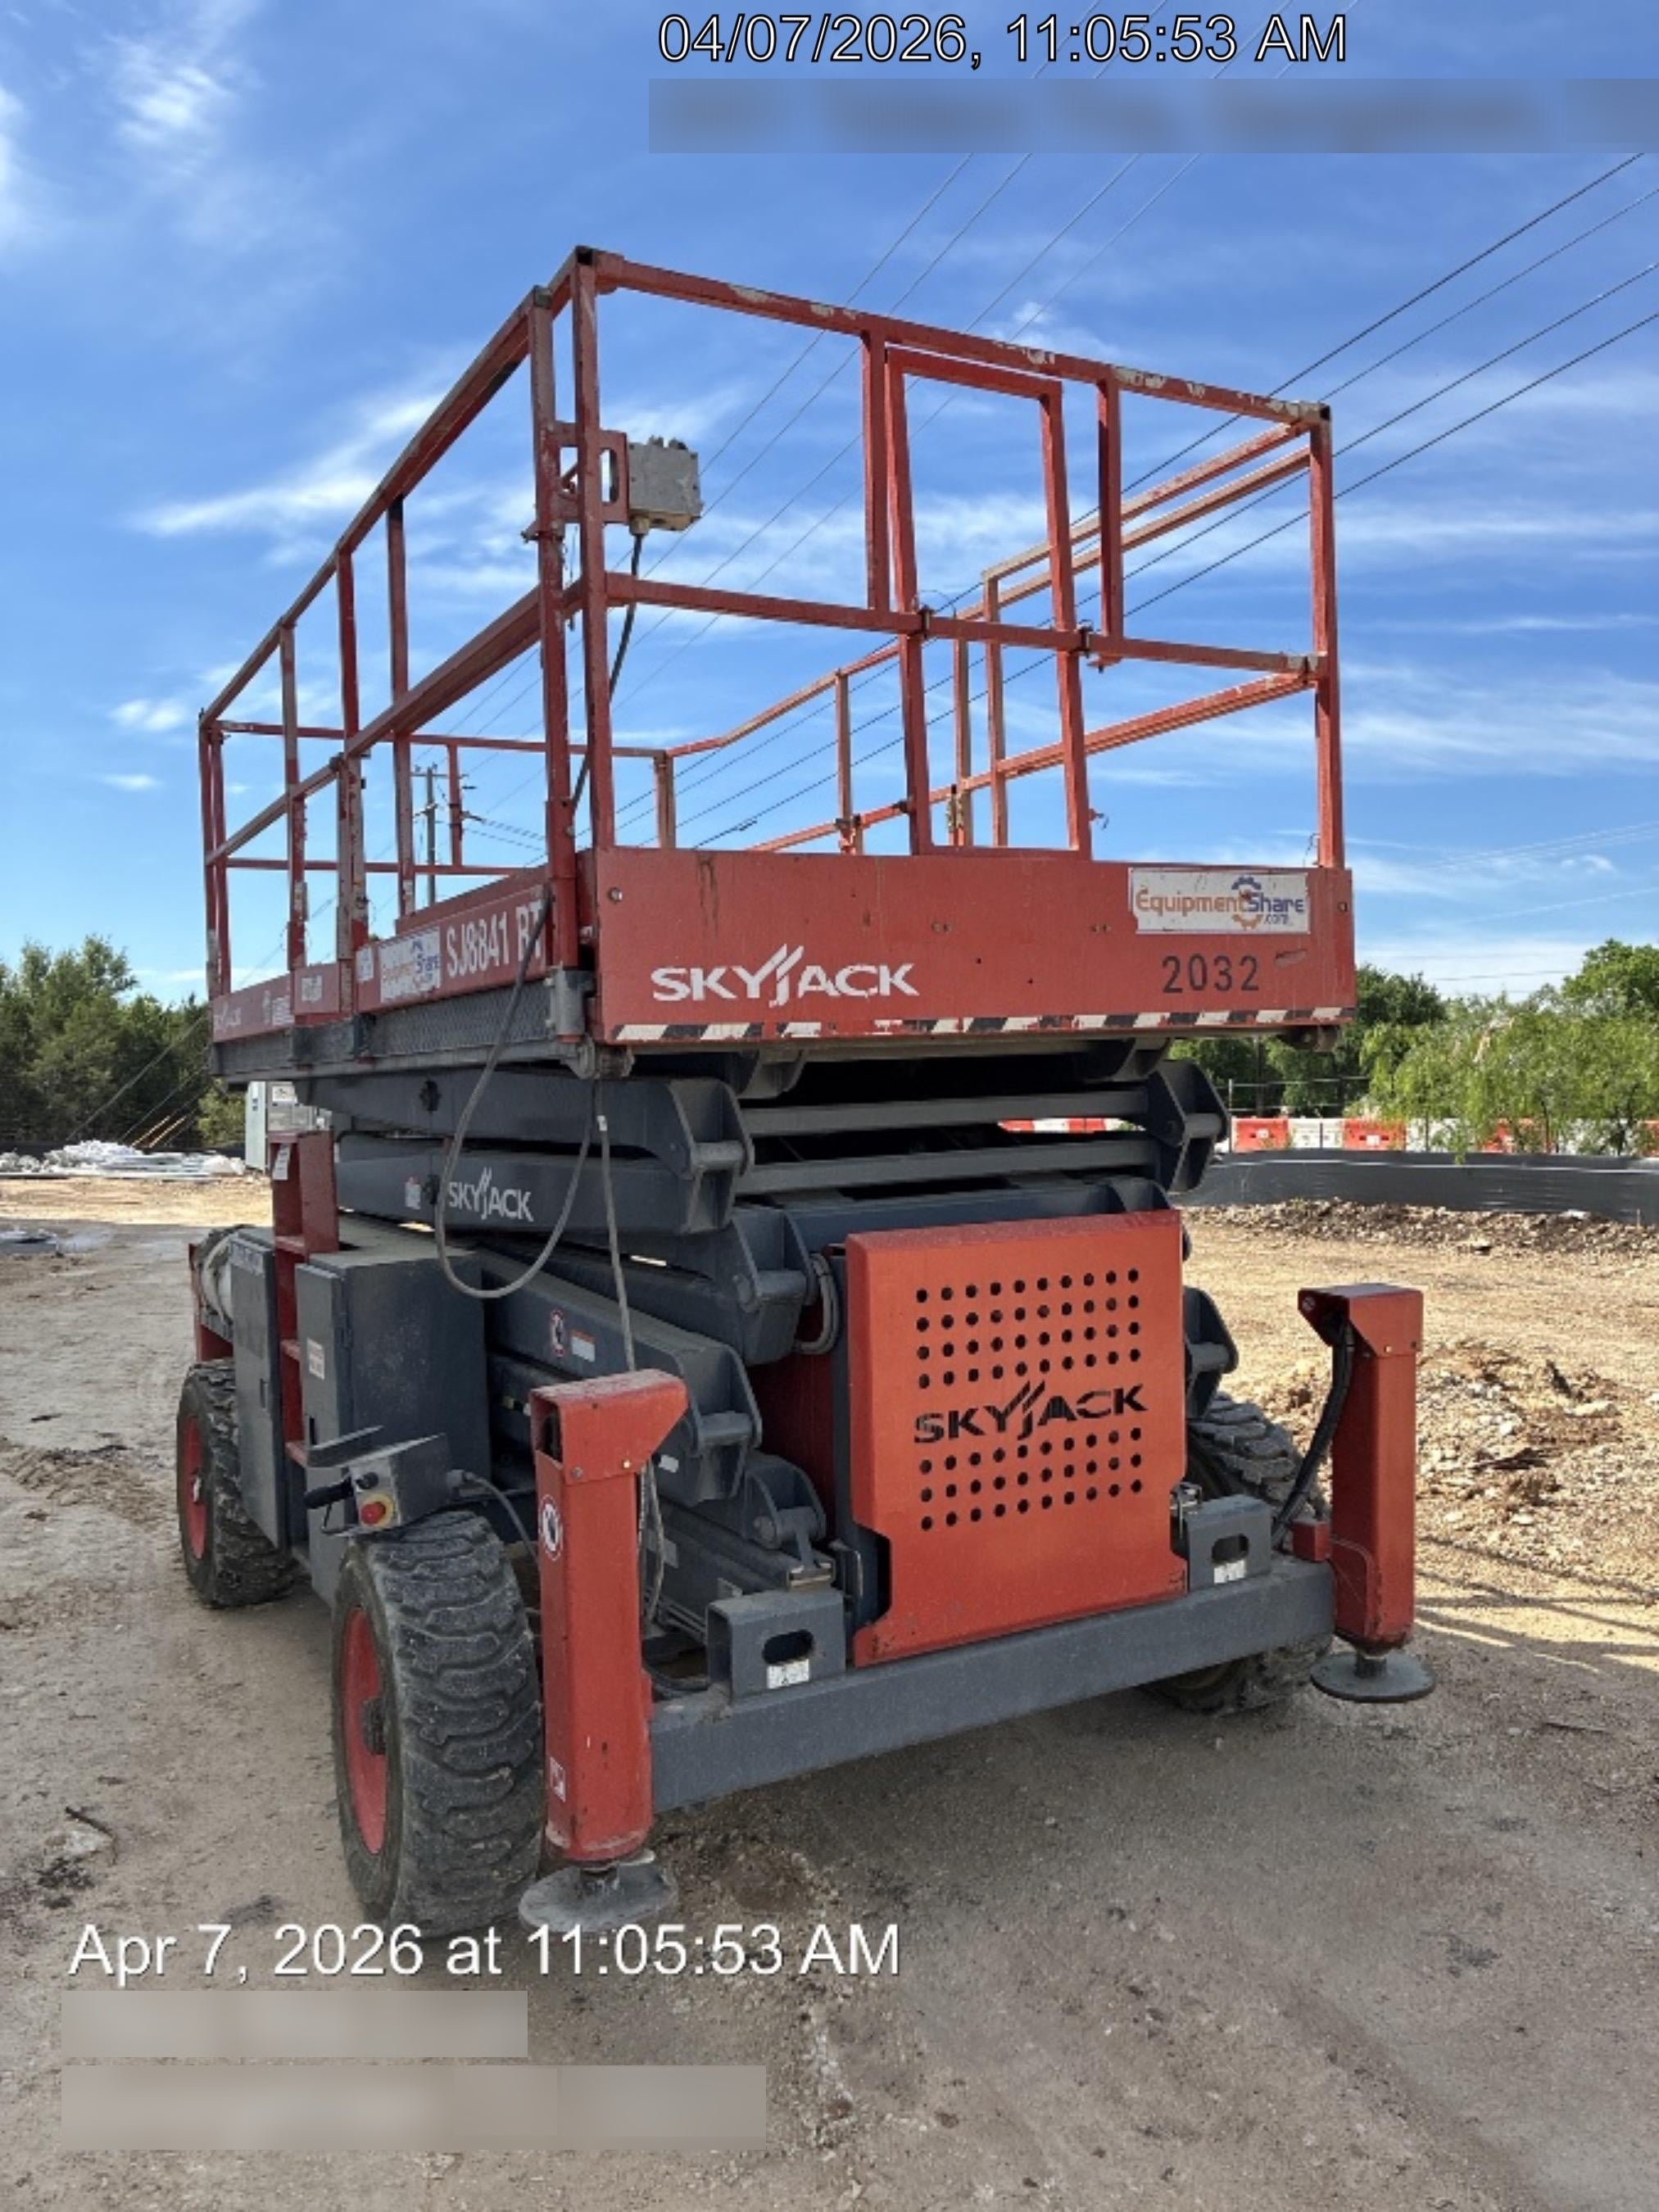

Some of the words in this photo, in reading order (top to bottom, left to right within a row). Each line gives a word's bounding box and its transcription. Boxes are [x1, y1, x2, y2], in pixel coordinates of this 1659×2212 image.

[1135, 886, 1305, 918] EquipmentShare
[446, 910, 510, 978] SJ8841
[1162, 954, 1259, 994] 2032
[650, 943, 920, 1009] SKYJACK
[448, 1166, 535, 1222] SKYJACK
[913, 1379, 1149, 1444] SKYJACK
